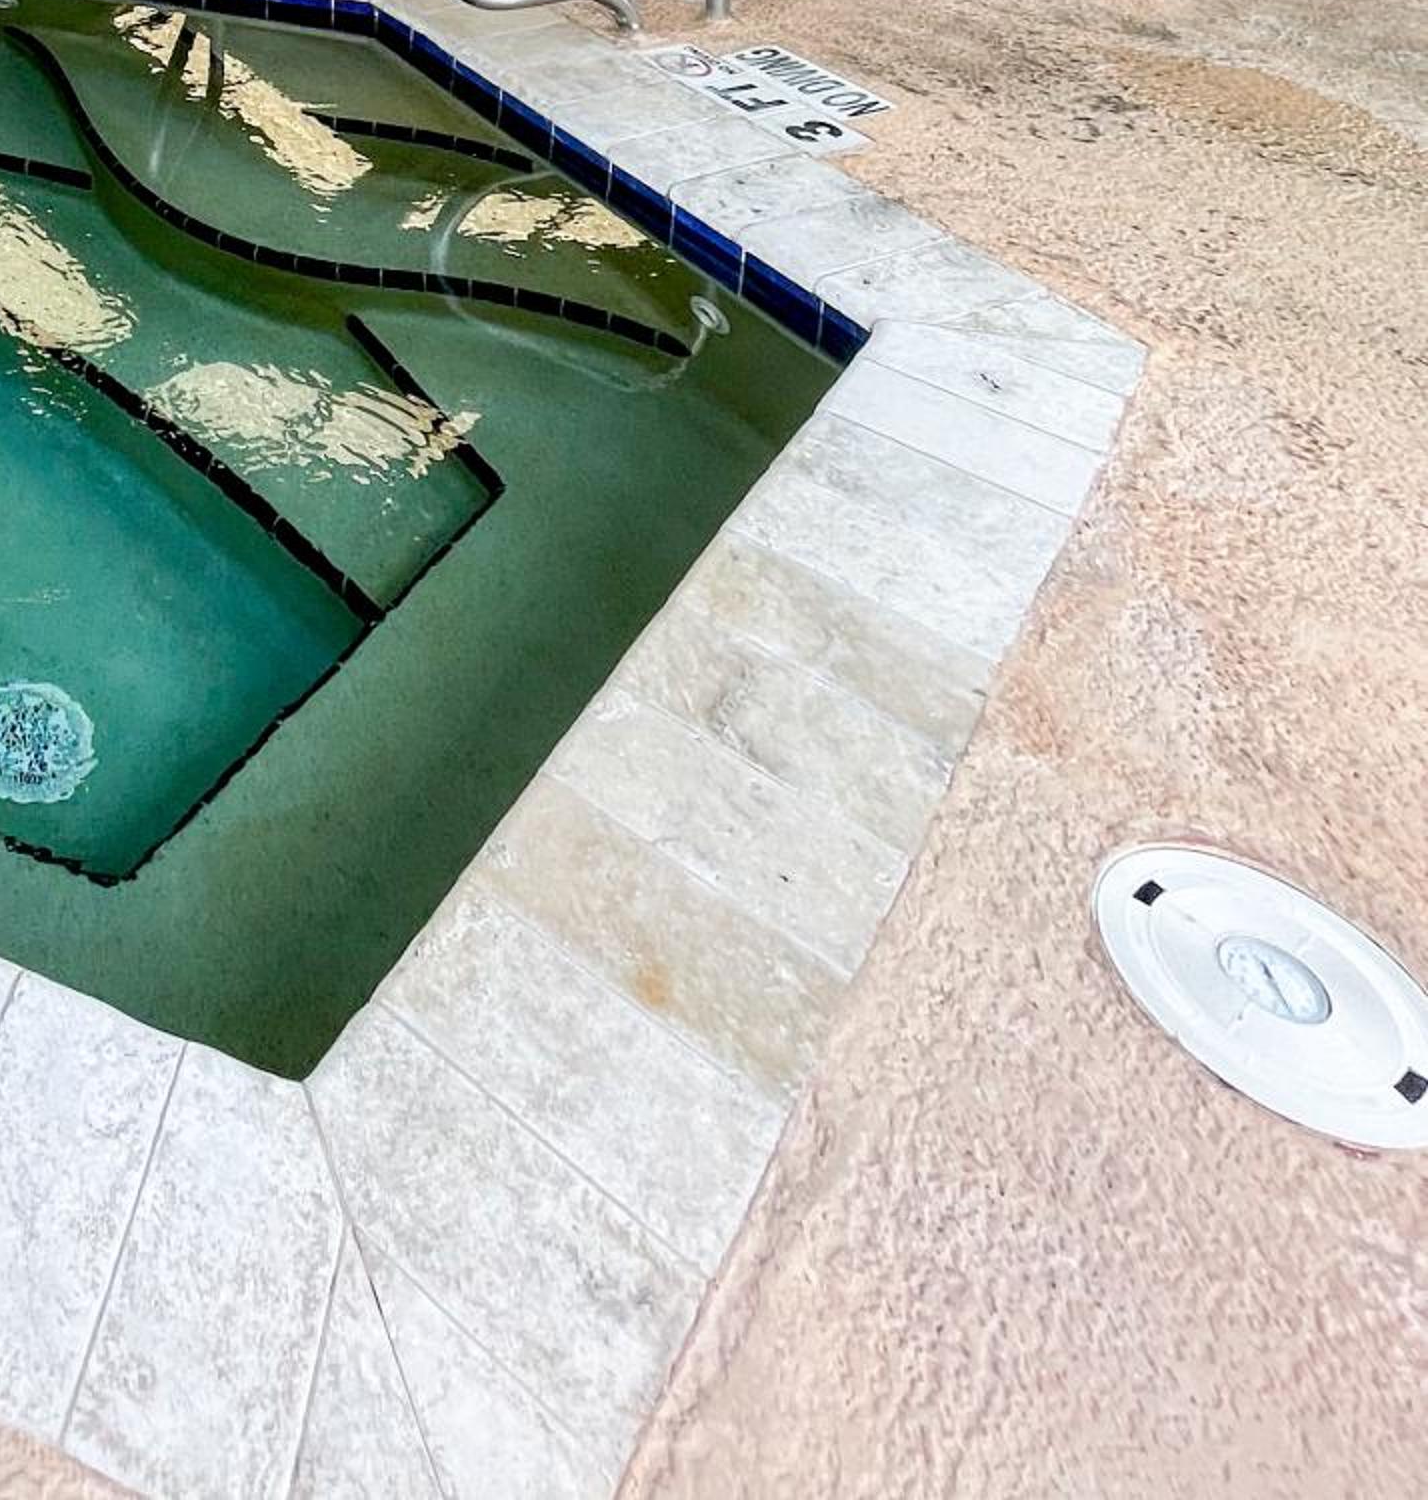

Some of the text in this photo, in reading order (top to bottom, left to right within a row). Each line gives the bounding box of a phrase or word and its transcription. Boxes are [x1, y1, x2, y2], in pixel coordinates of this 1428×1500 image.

[735, 47, 845, 94] DIVING
[704, 83, 843, 143] 3 FT
[822, 90, 891, 118] NO
